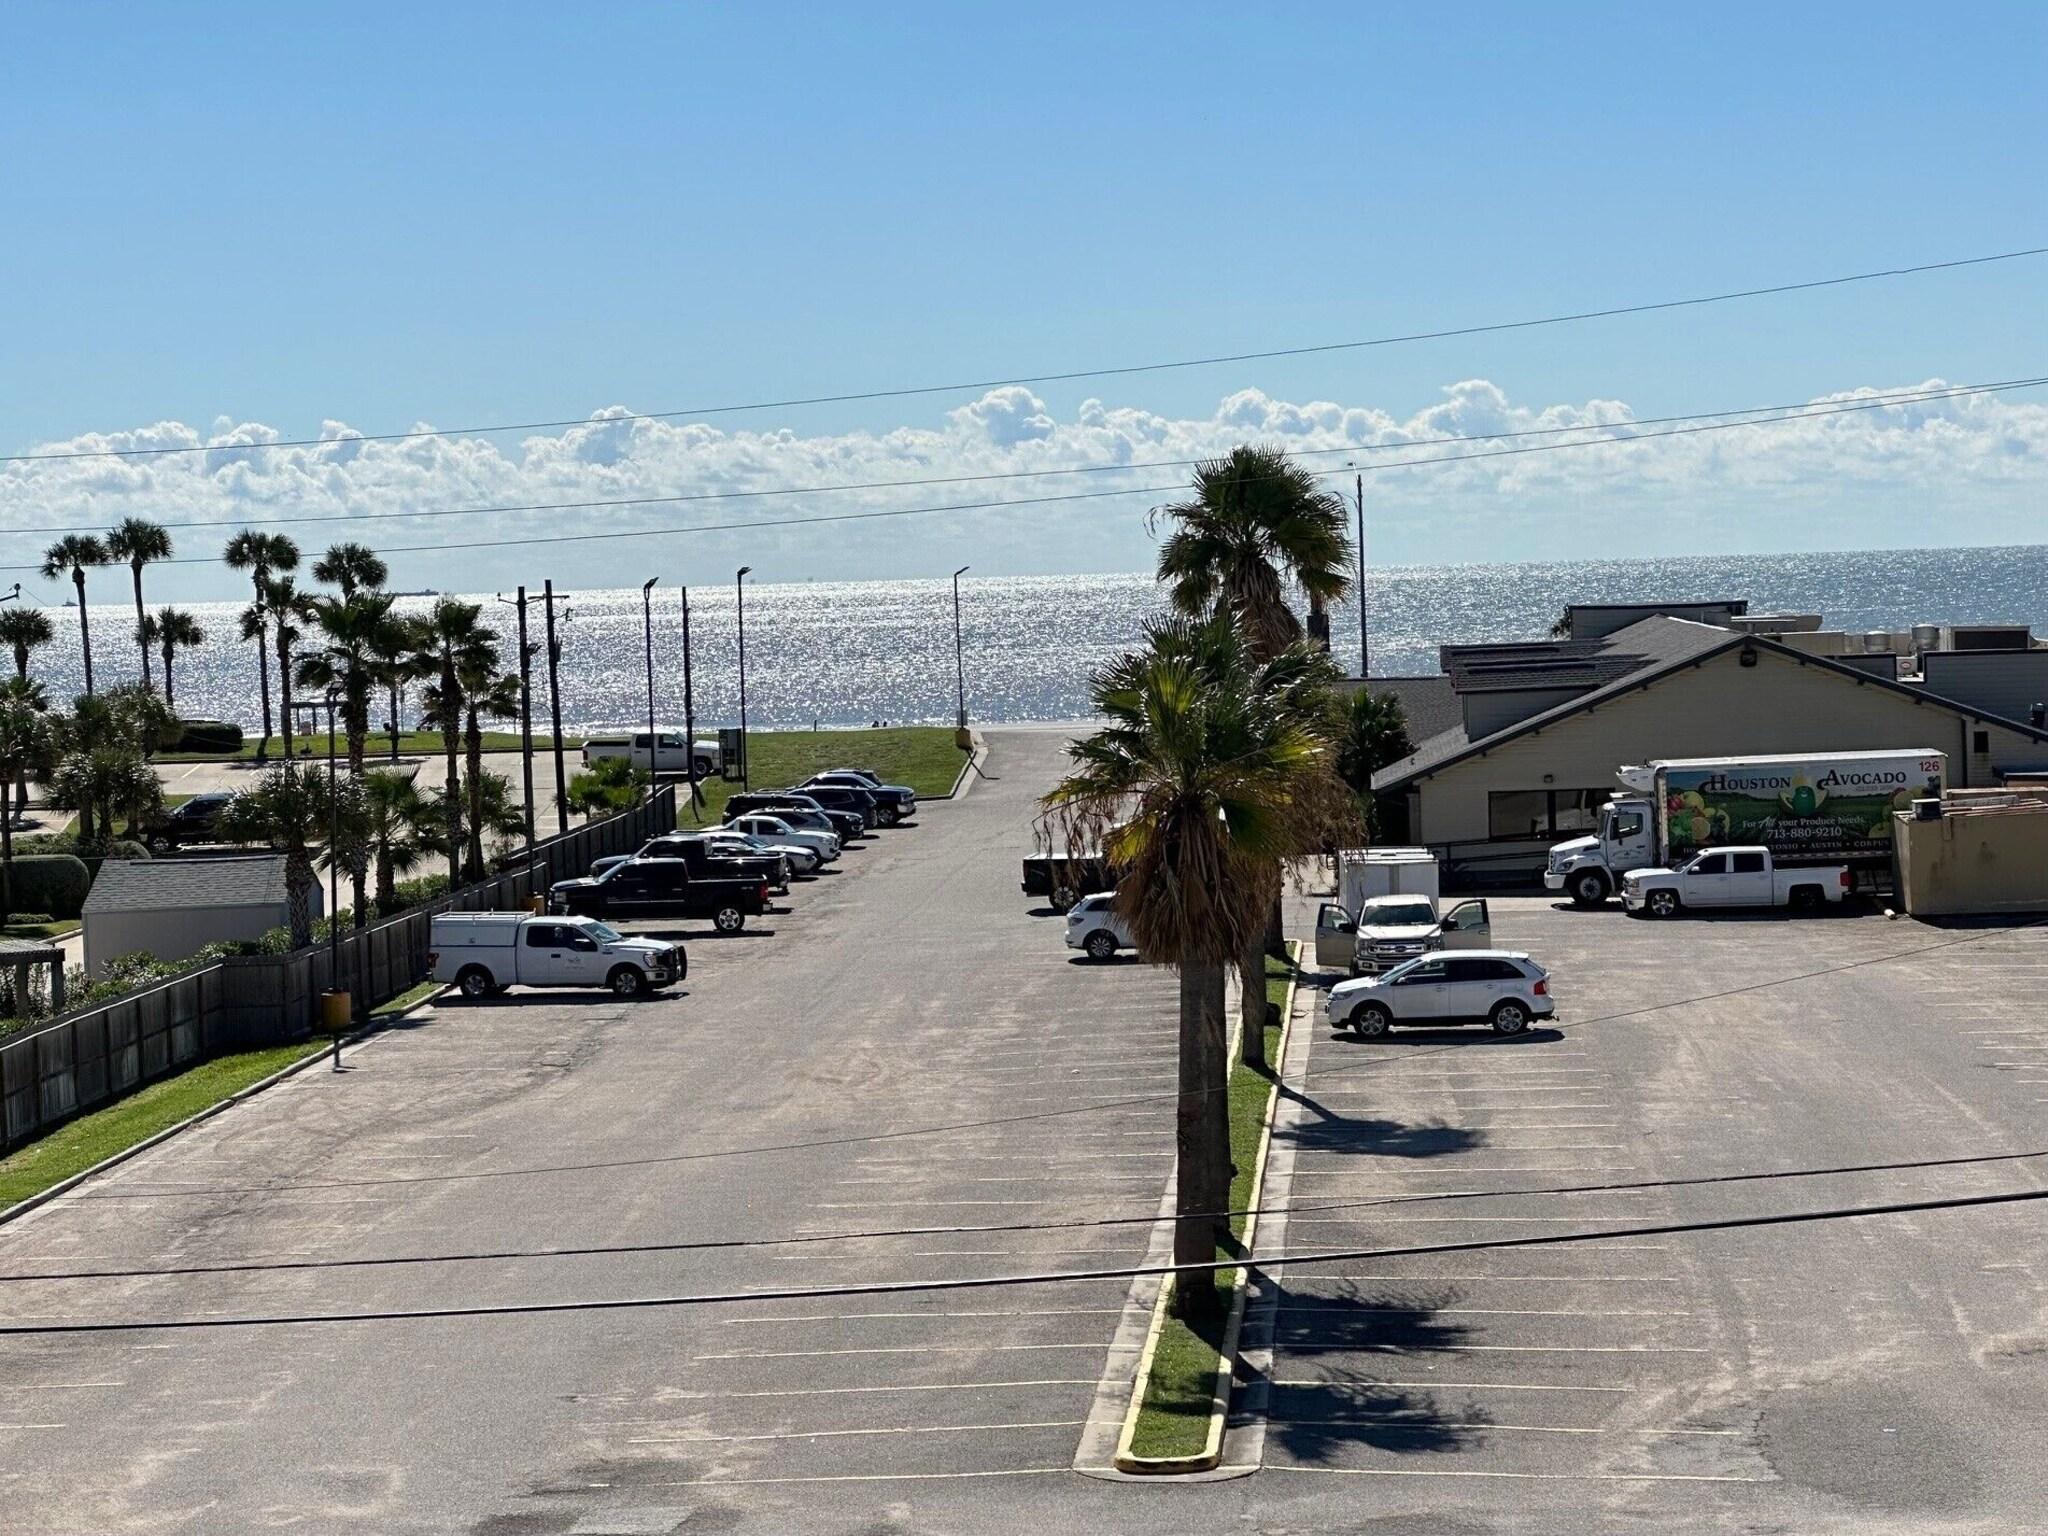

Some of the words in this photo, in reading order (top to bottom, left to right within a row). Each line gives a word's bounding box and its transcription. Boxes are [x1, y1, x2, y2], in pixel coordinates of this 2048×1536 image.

[1919, 760, 1940, 772] 126
[1698, 774, 1791, 792] HOUSTON
[1816, 769, 1906, 790] AVOCADO
[1743, 820, 1756, 828] For
[1778, 819, 1798, 827] your
[1800, 816, 1835, 825] Produce
[1767, 827, 1842, 839] 713-880-9210
[1810, 841, 1842, 849] AUSTIN
